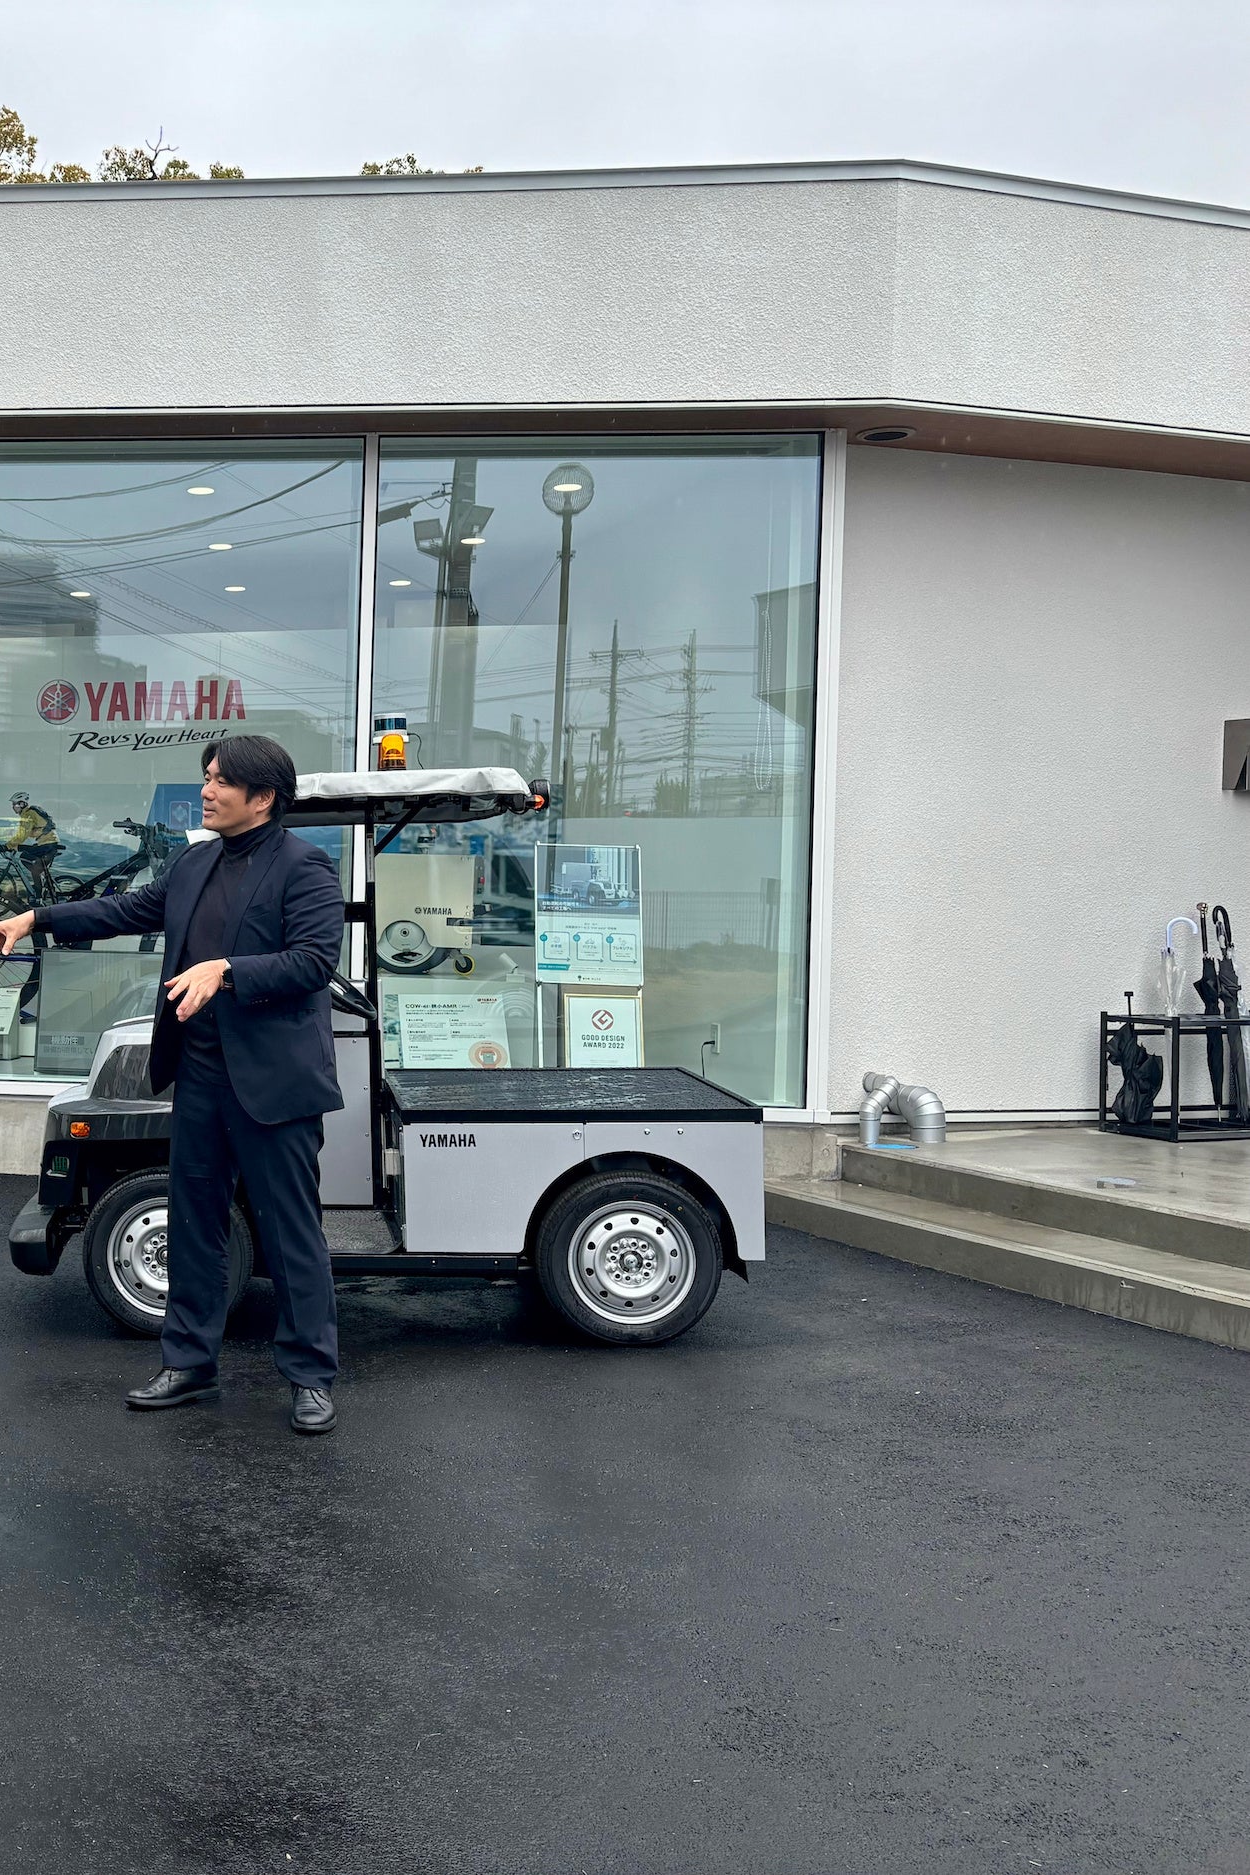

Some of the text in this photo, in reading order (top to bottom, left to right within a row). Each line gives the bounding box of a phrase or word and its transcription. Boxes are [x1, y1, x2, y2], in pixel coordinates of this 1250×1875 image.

[83, 679, 246, 722] YAMAHA
[68, 728, 231, 753] Revs Your Heart
[422, 907, 452, 915] YAMAHA
[601, 1034, 626, 1042] DESIGN
[419, 1133, 477, 1148] YAMAHA
